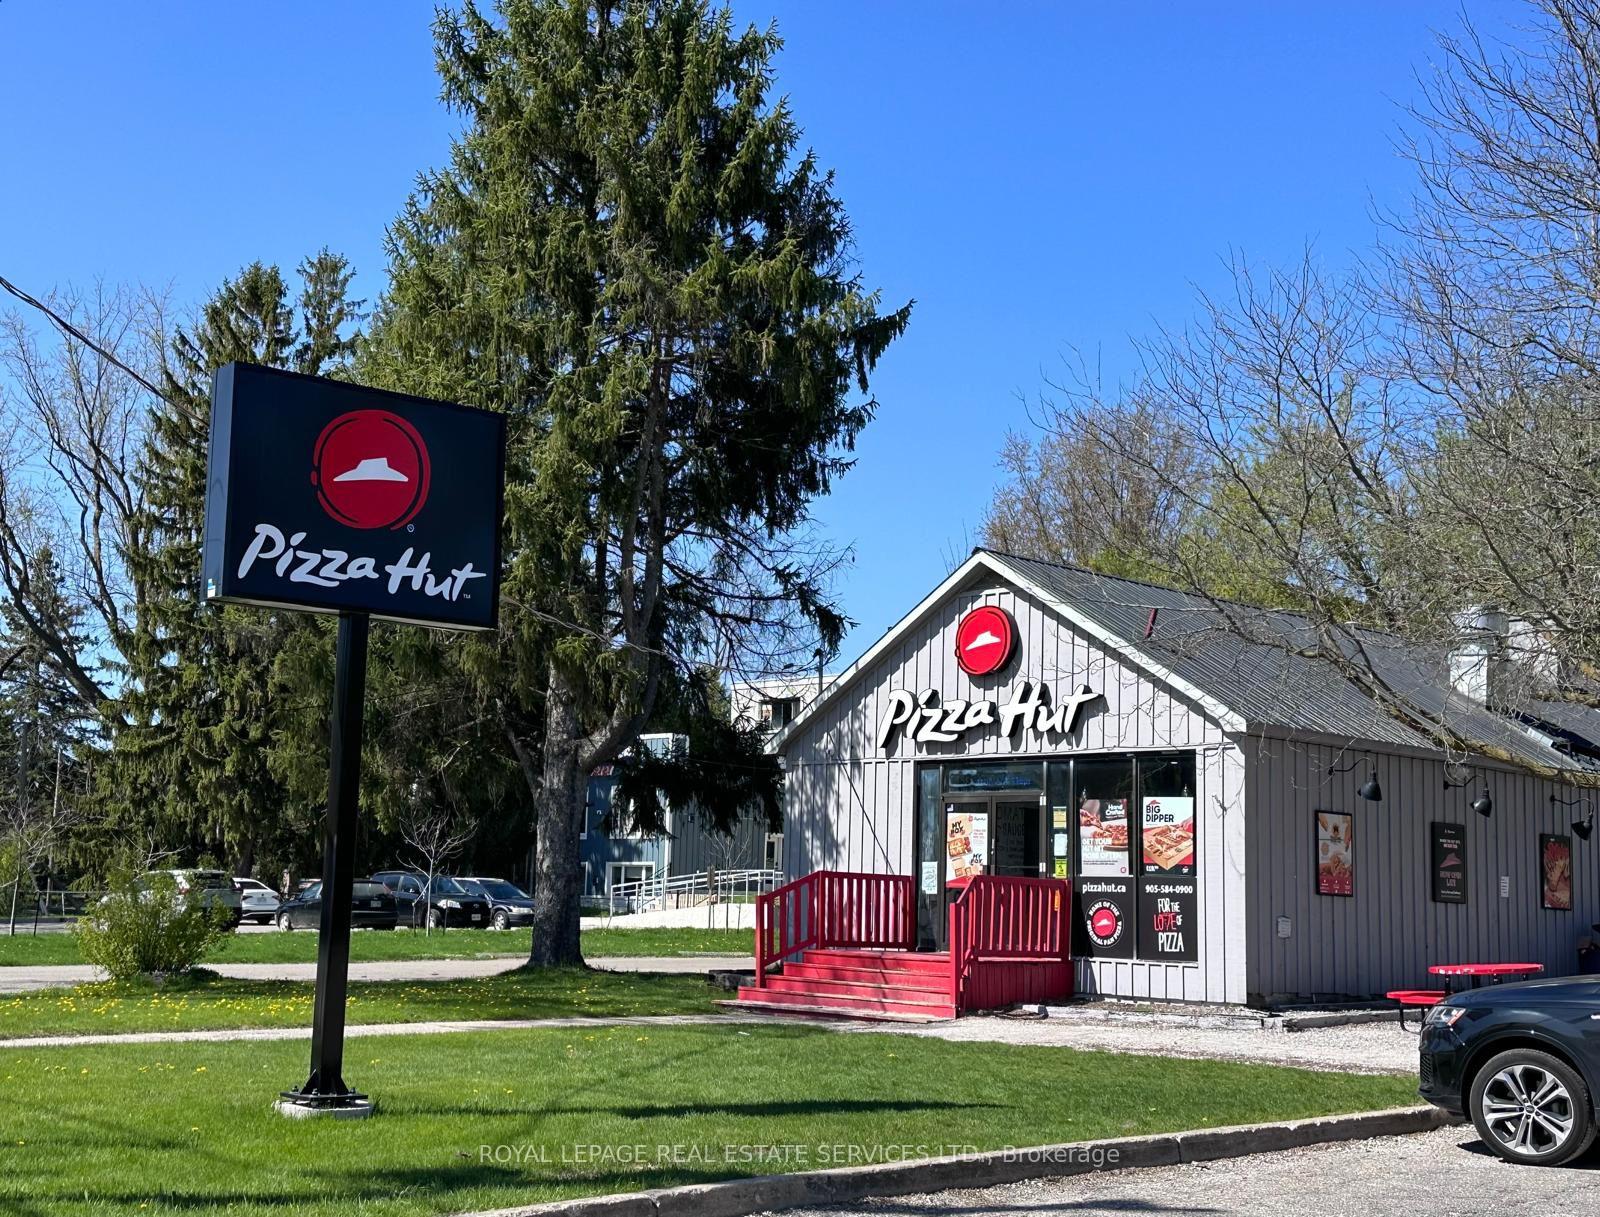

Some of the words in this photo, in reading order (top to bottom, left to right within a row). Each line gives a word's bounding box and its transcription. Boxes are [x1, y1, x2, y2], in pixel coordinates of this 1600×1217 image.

[237, 523, 380, 588] Pizza
[384, 546, 487, 602] Hut
[877, 688, 996, 749] Pizza
[998, 680, 1102, 738] Hut
[1145, 805, 1161, 814] BIG
[951, 820, 962, 829] MY
[1145, 814, 1175, 823] DIPPER
[1082, 882, 1126, 894] pizzahut.ca
[1145, 884, 1193, 894] 905-584-0900
[1157, 898, 1171, 913] FOR
[1170, 901, 1181, 913] THE
[1176, 914, 1183, 926] OF
[1158, 932, 1185, 952] PIZZA
